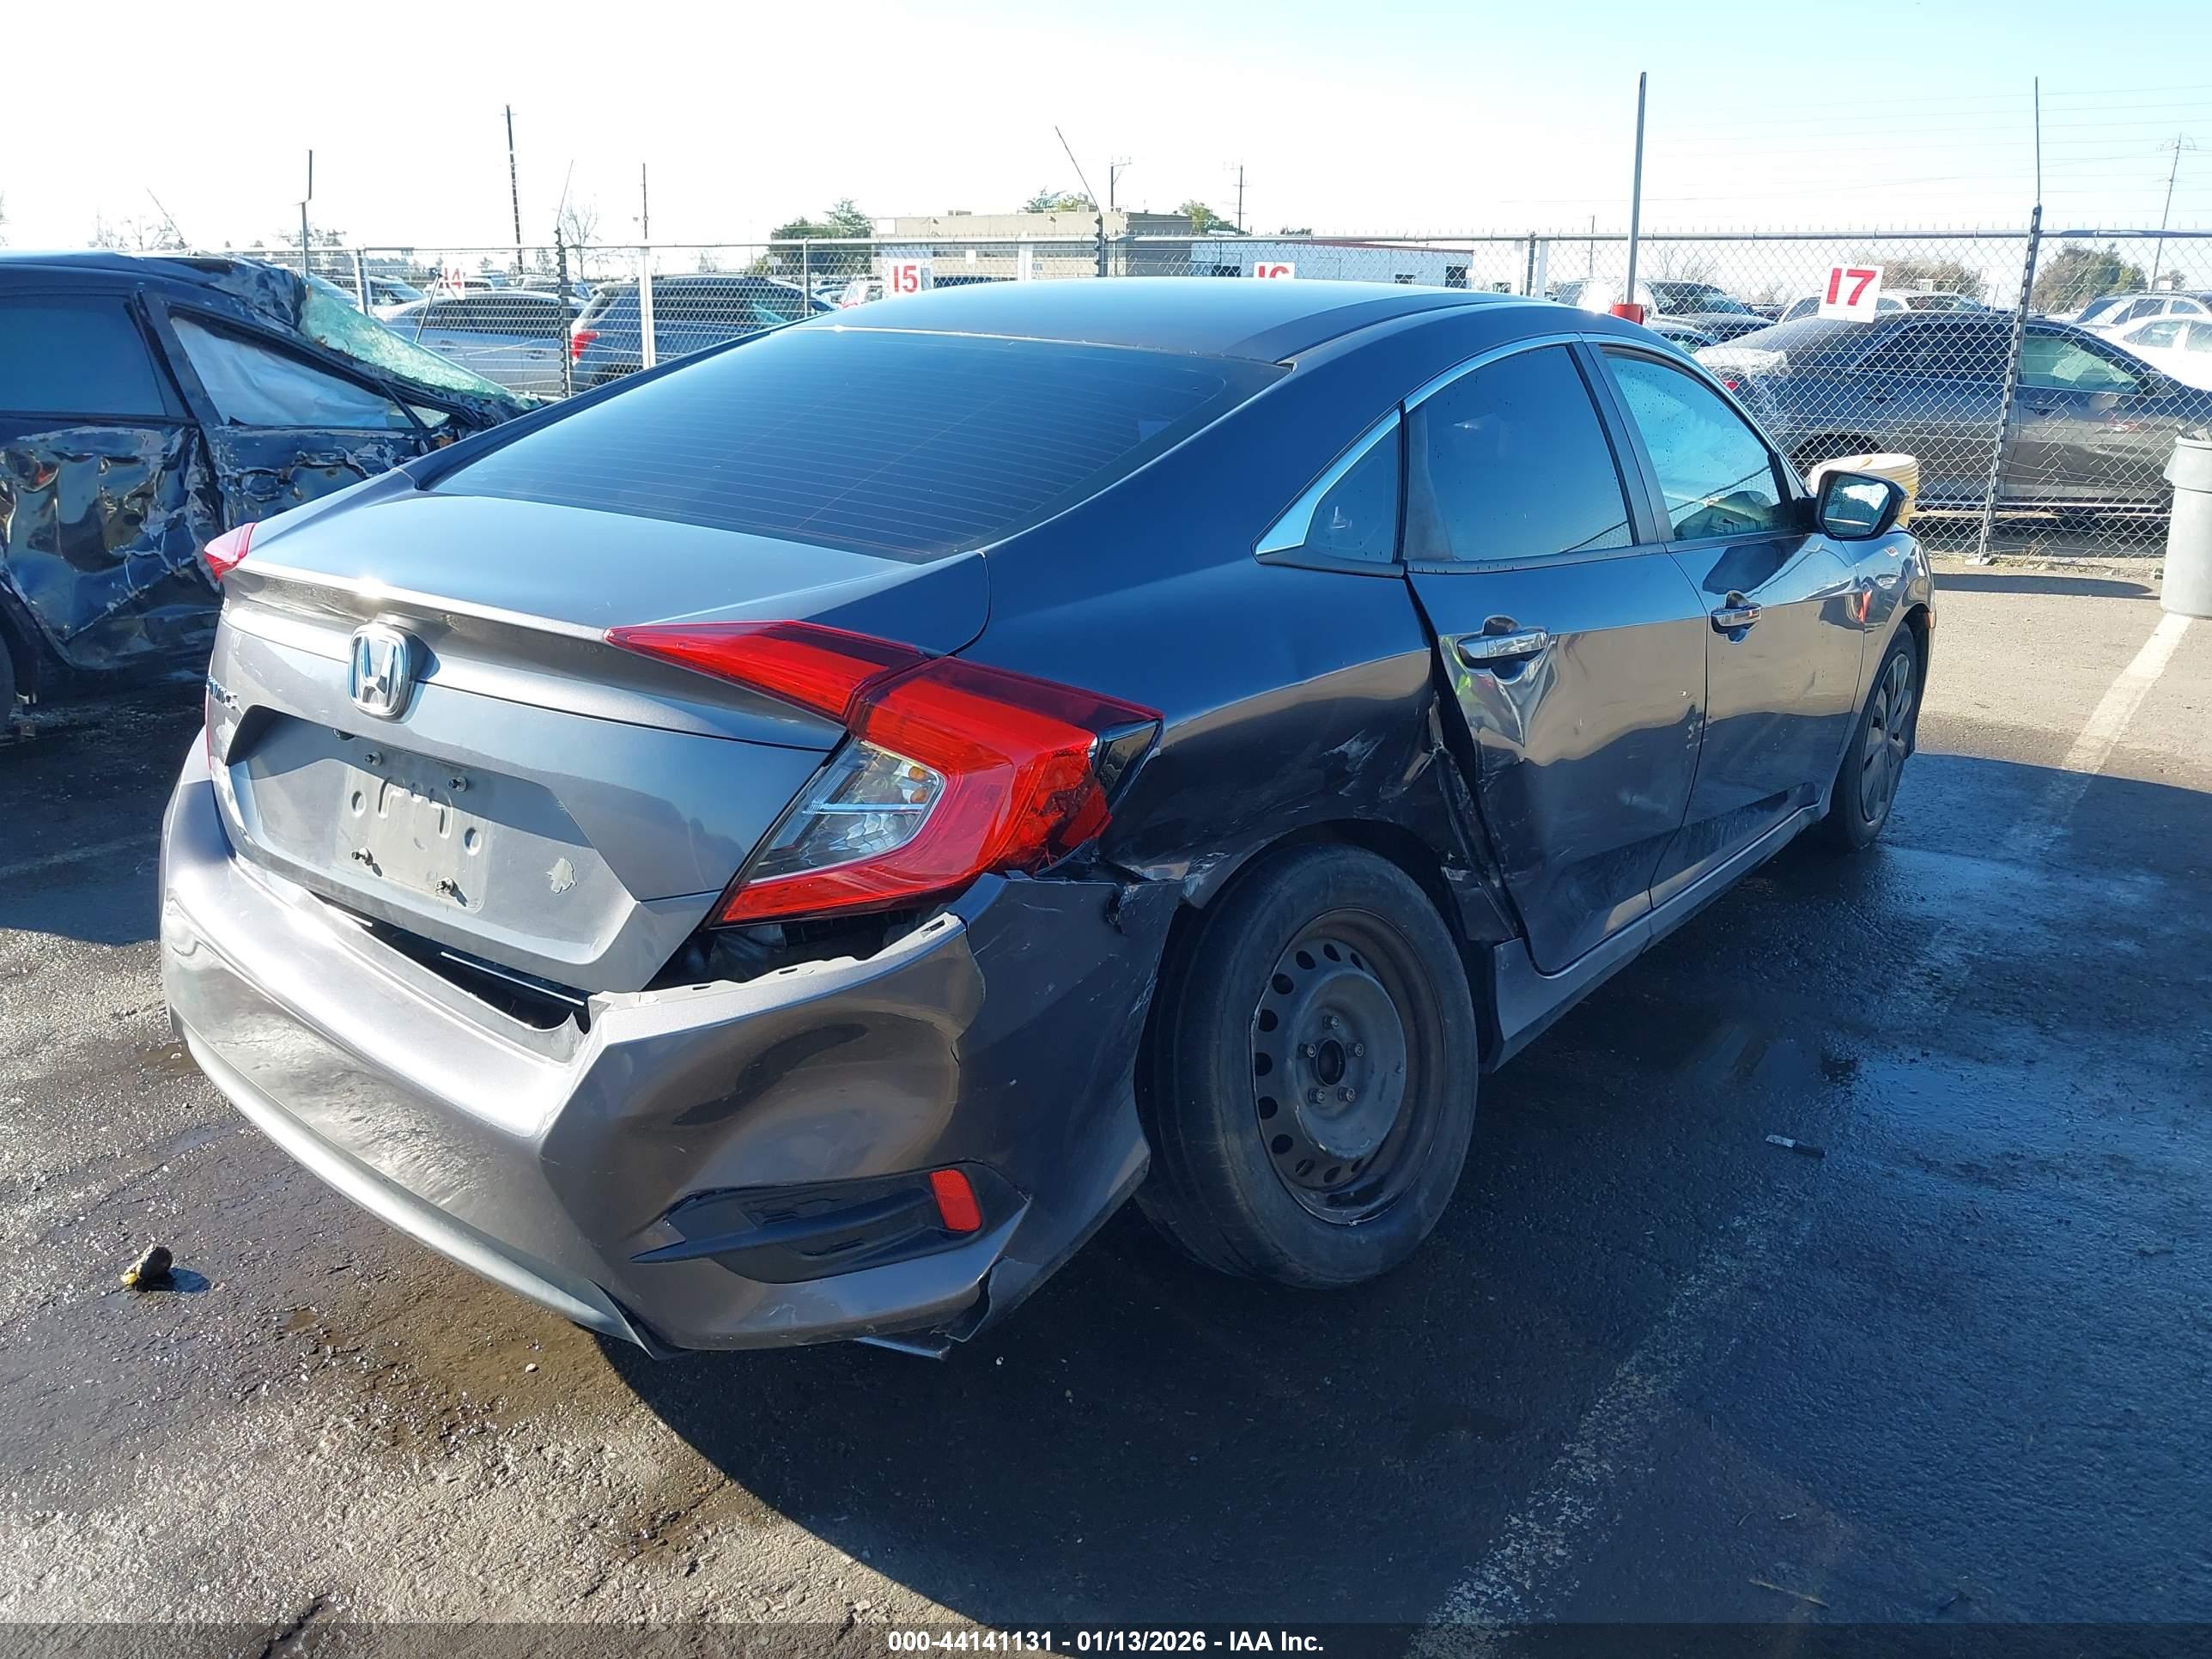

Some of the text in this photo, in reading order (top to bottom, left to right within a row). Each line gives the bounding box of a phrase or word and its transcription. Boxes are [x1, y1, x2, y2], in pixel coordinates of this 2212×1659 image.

[444, 267, 462, 289] 14
[893, 265, 918, 293] 15
[1826, 267, 1877, 306] 17
